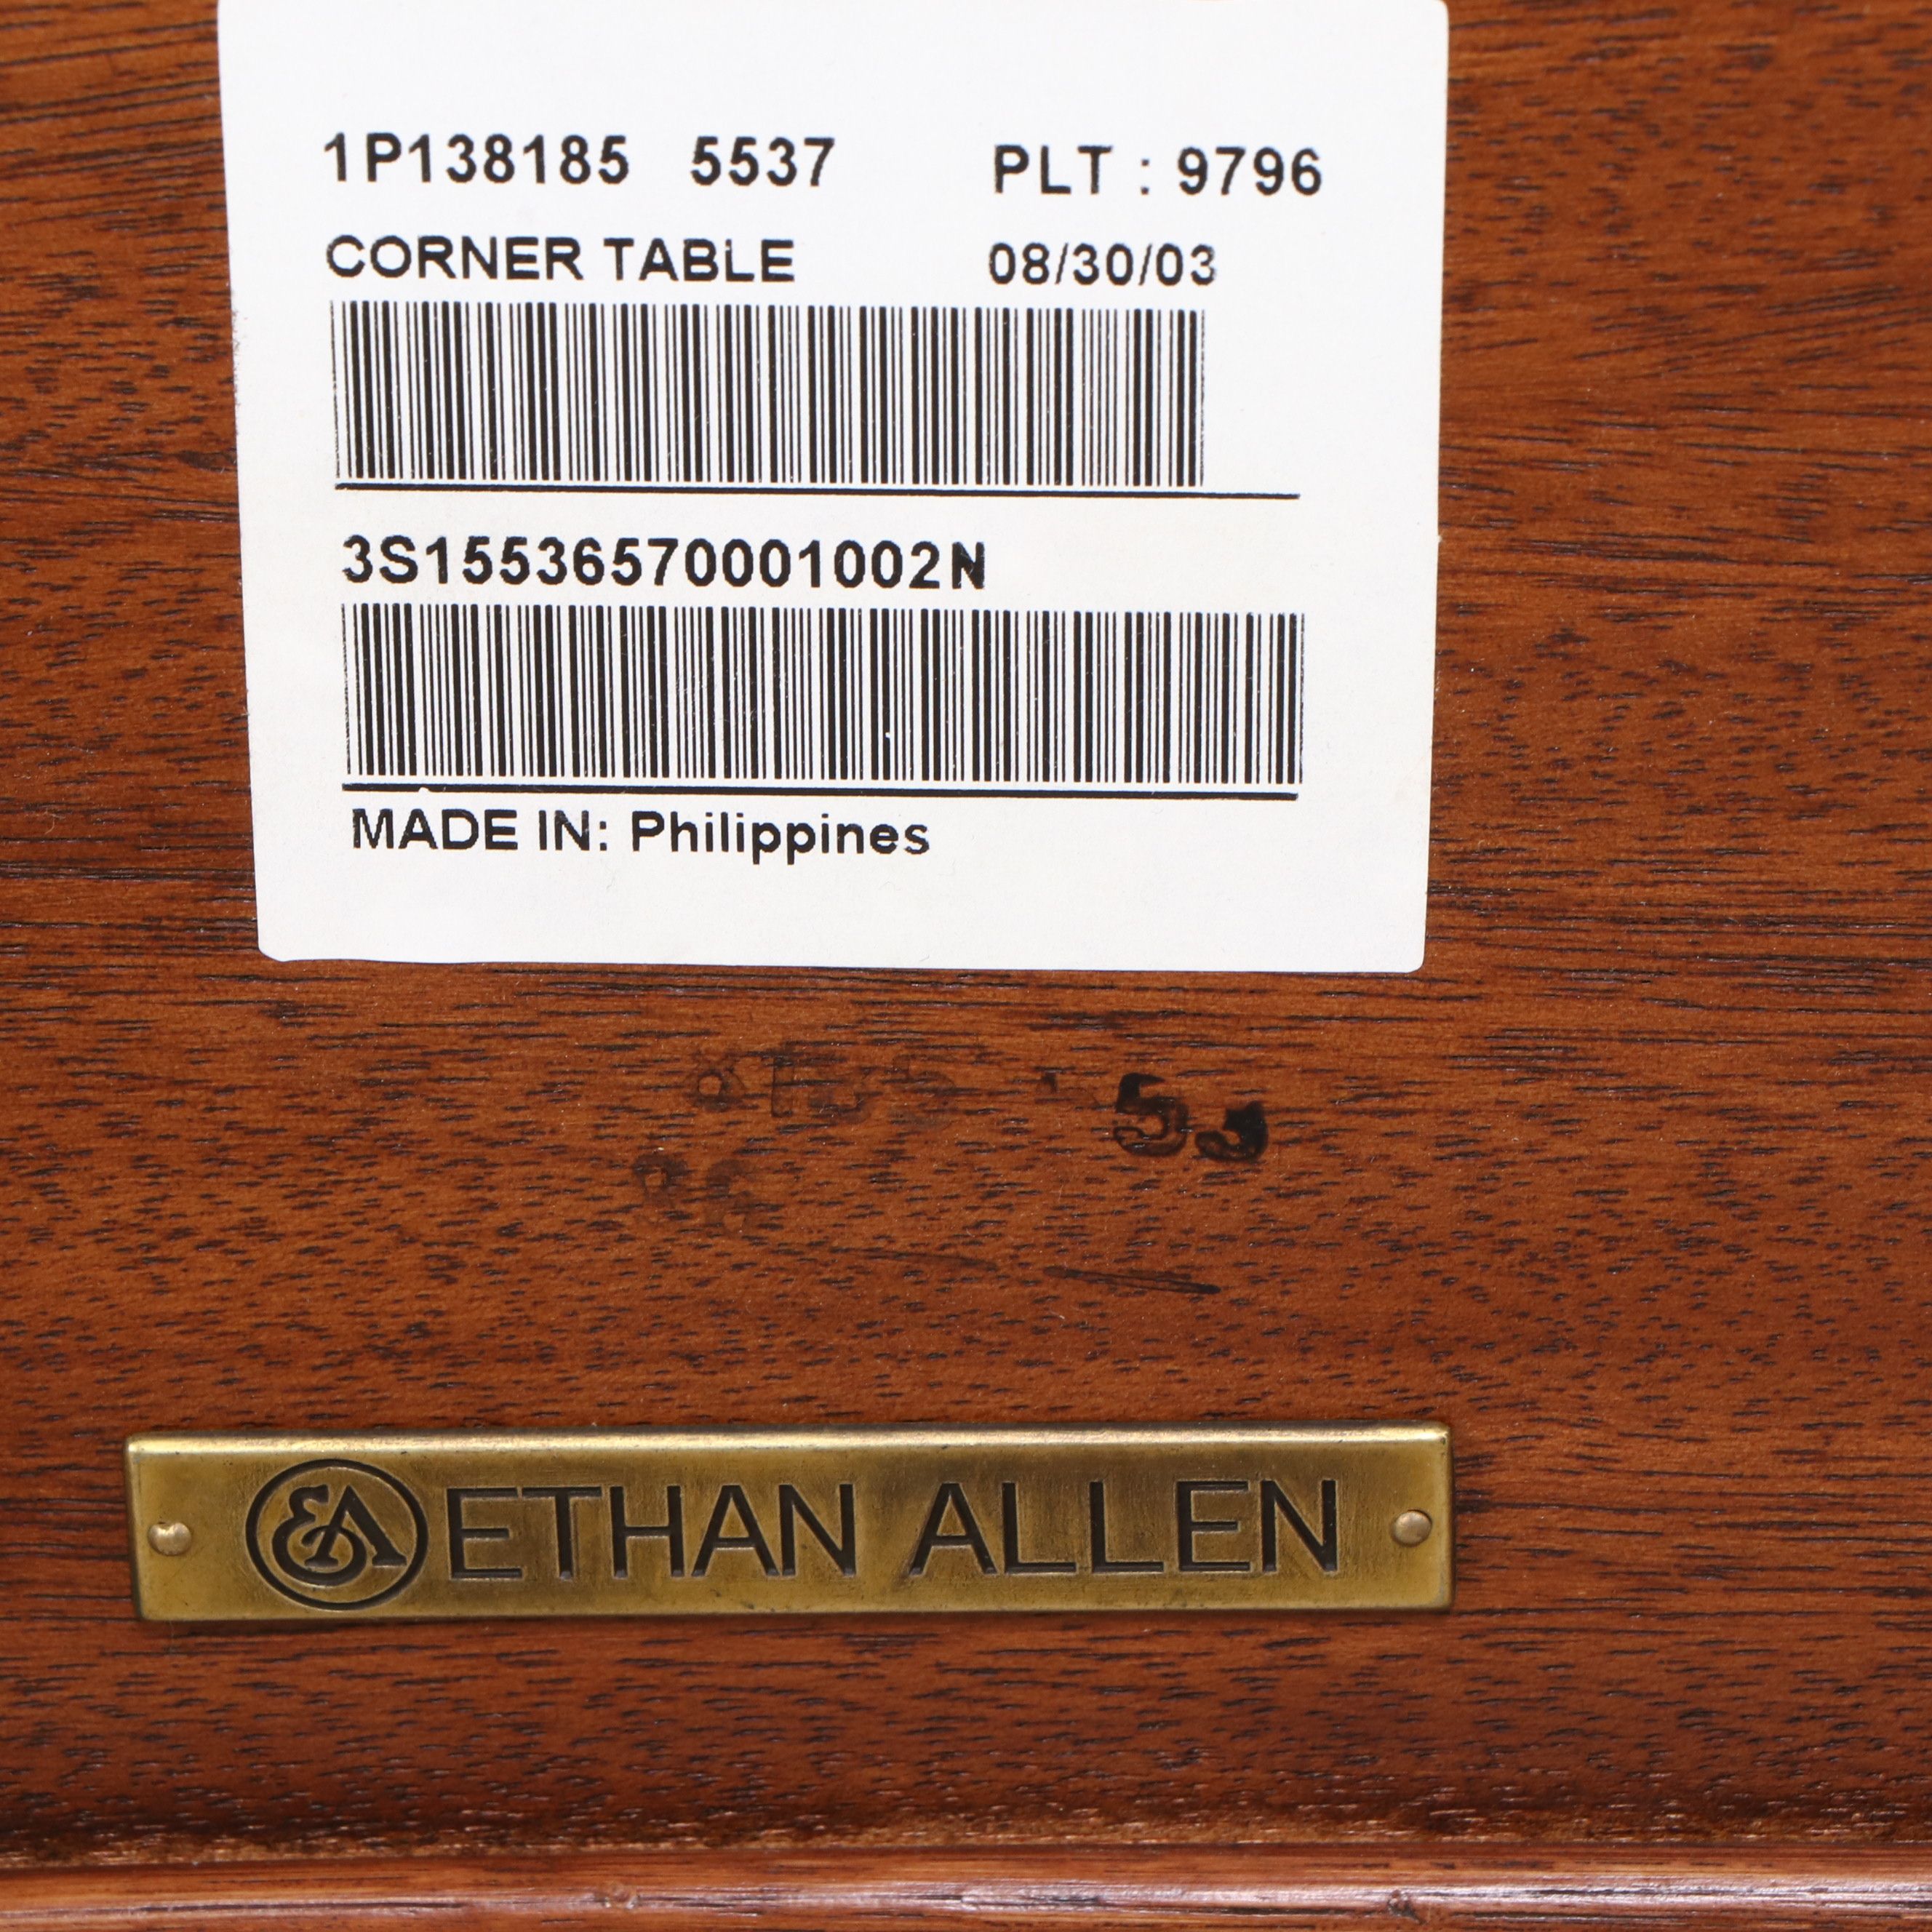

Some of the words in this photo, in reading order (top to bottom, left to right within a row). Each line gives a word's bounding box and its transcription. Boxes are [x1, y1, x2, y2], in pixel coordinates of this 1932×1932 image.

[324, 132, 629, 184] 1P138185
[690, 136, 835, 187] 5537
[994, 145, 1112, 195] PLT
[1177, 147, 1322, 196] 9796
[326, 235, 583, 280] CORNER
[603, 237, 794, 282] TABLE
[988, 242, 1216, 286] 08/30/03
[342, 535, 986, 590] 3S15536570001002N
[352, 808, 518, 850] MADE
[538, 810, 607, 851] IN:
[631, 810, 930, 866] Philippines
[447, 1482, 855, 1578] ETHAN
[909, 1479, 1338, 1576] ALLEN
